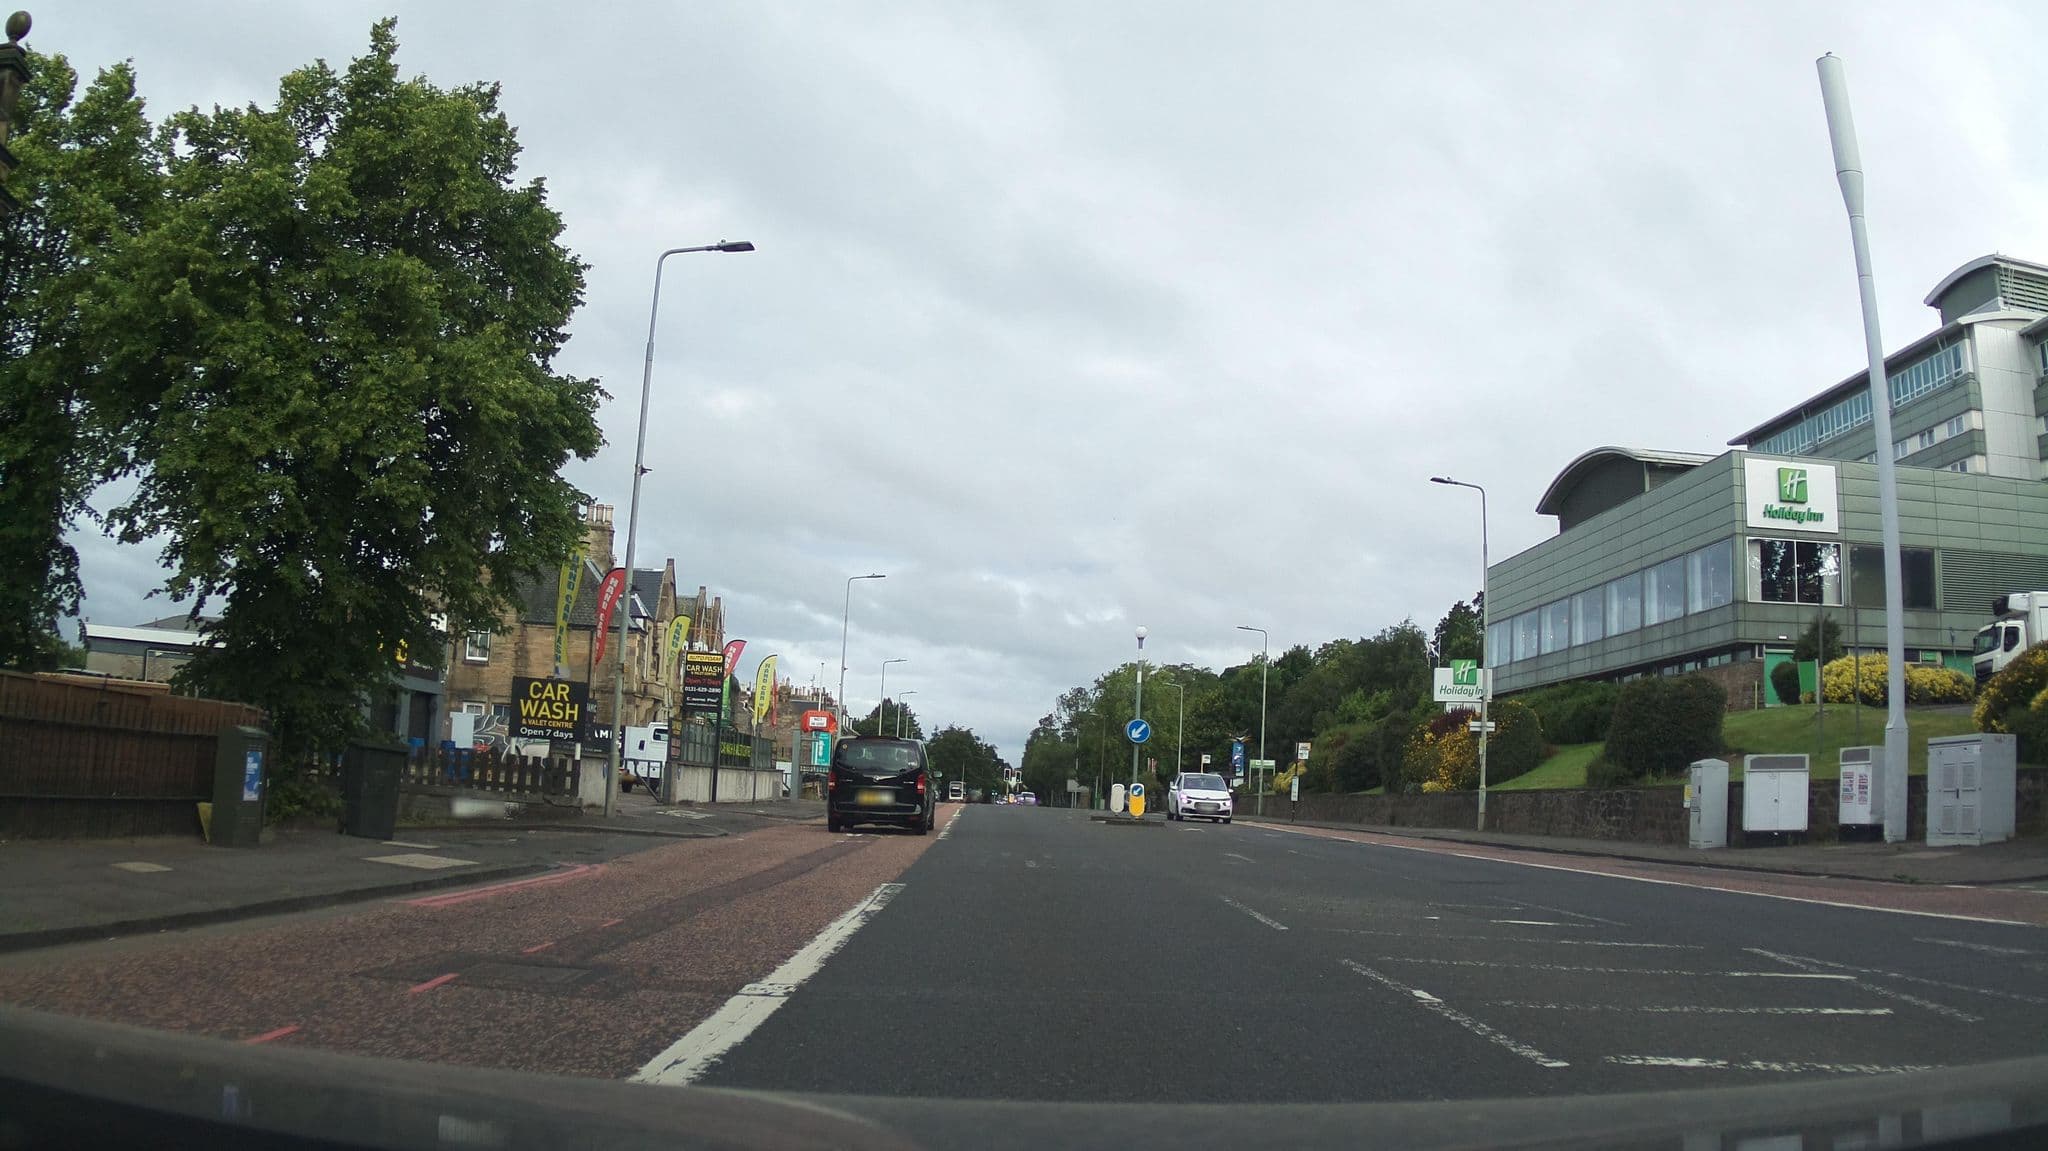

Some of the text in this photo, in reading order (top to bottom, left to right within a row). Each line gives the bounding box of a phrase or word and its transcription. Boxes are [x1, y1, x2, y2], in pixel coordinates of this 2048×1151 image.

[1763, 504, 1824, 524] Holiday Inn
[602, 577, 619, 610] HAND
[702, 665, 722, 673] WASH
[530, 681, 570, 701] CAR
[1440, 685, 1475, 697] Holiday
[520, 699, 579, 721] WASH
[548, 720, 574, 729] CENTRE
[520, 727, 544, 736] Open
[553, 730, 574, 739] days
